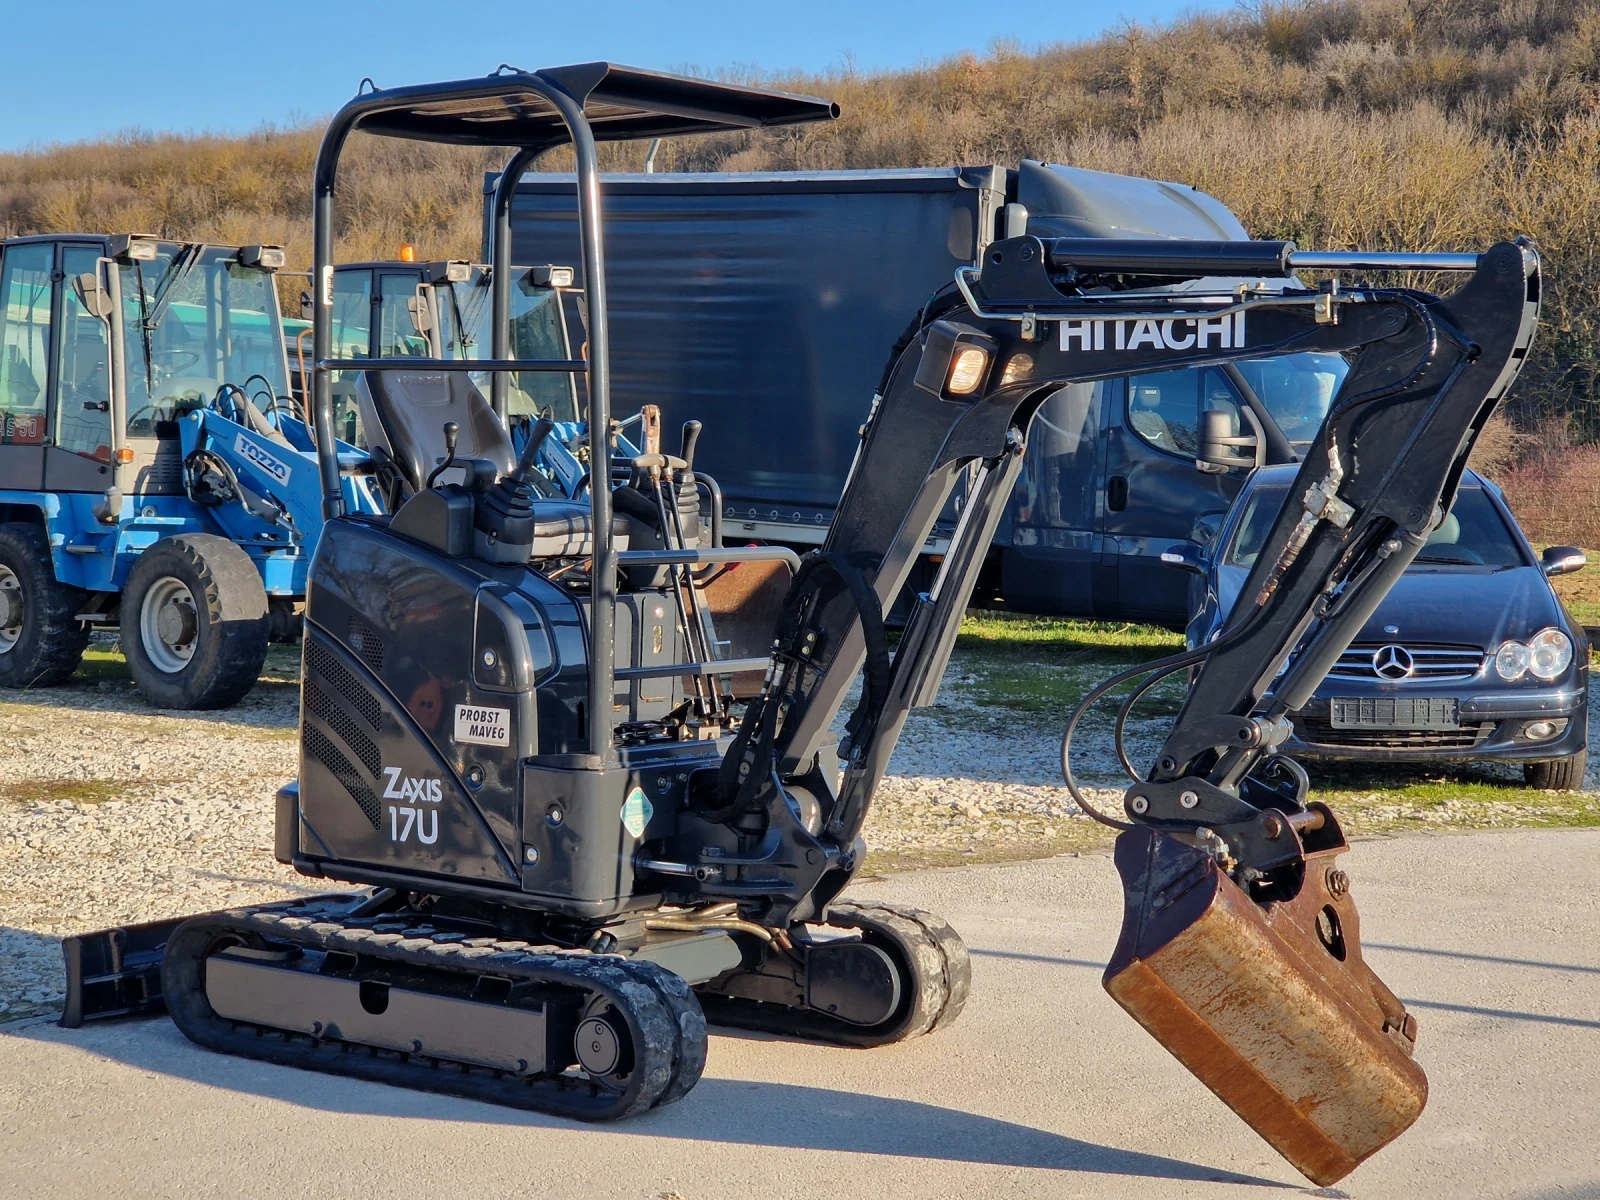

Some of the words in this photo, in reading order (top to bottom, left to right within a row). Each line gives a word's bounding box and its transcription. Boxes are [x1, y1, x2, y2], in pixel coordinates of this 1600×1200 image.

[1060, 310, 1245, 351] HITACHI
[241, 437, 286, 480] TOZZO
[460, 708, 500, 724] PROBST
[469, 724, 505, 740] MAVEG
[383, 766, 443, 804] ZAXIS
[389, 806, 439, 845] 17U
